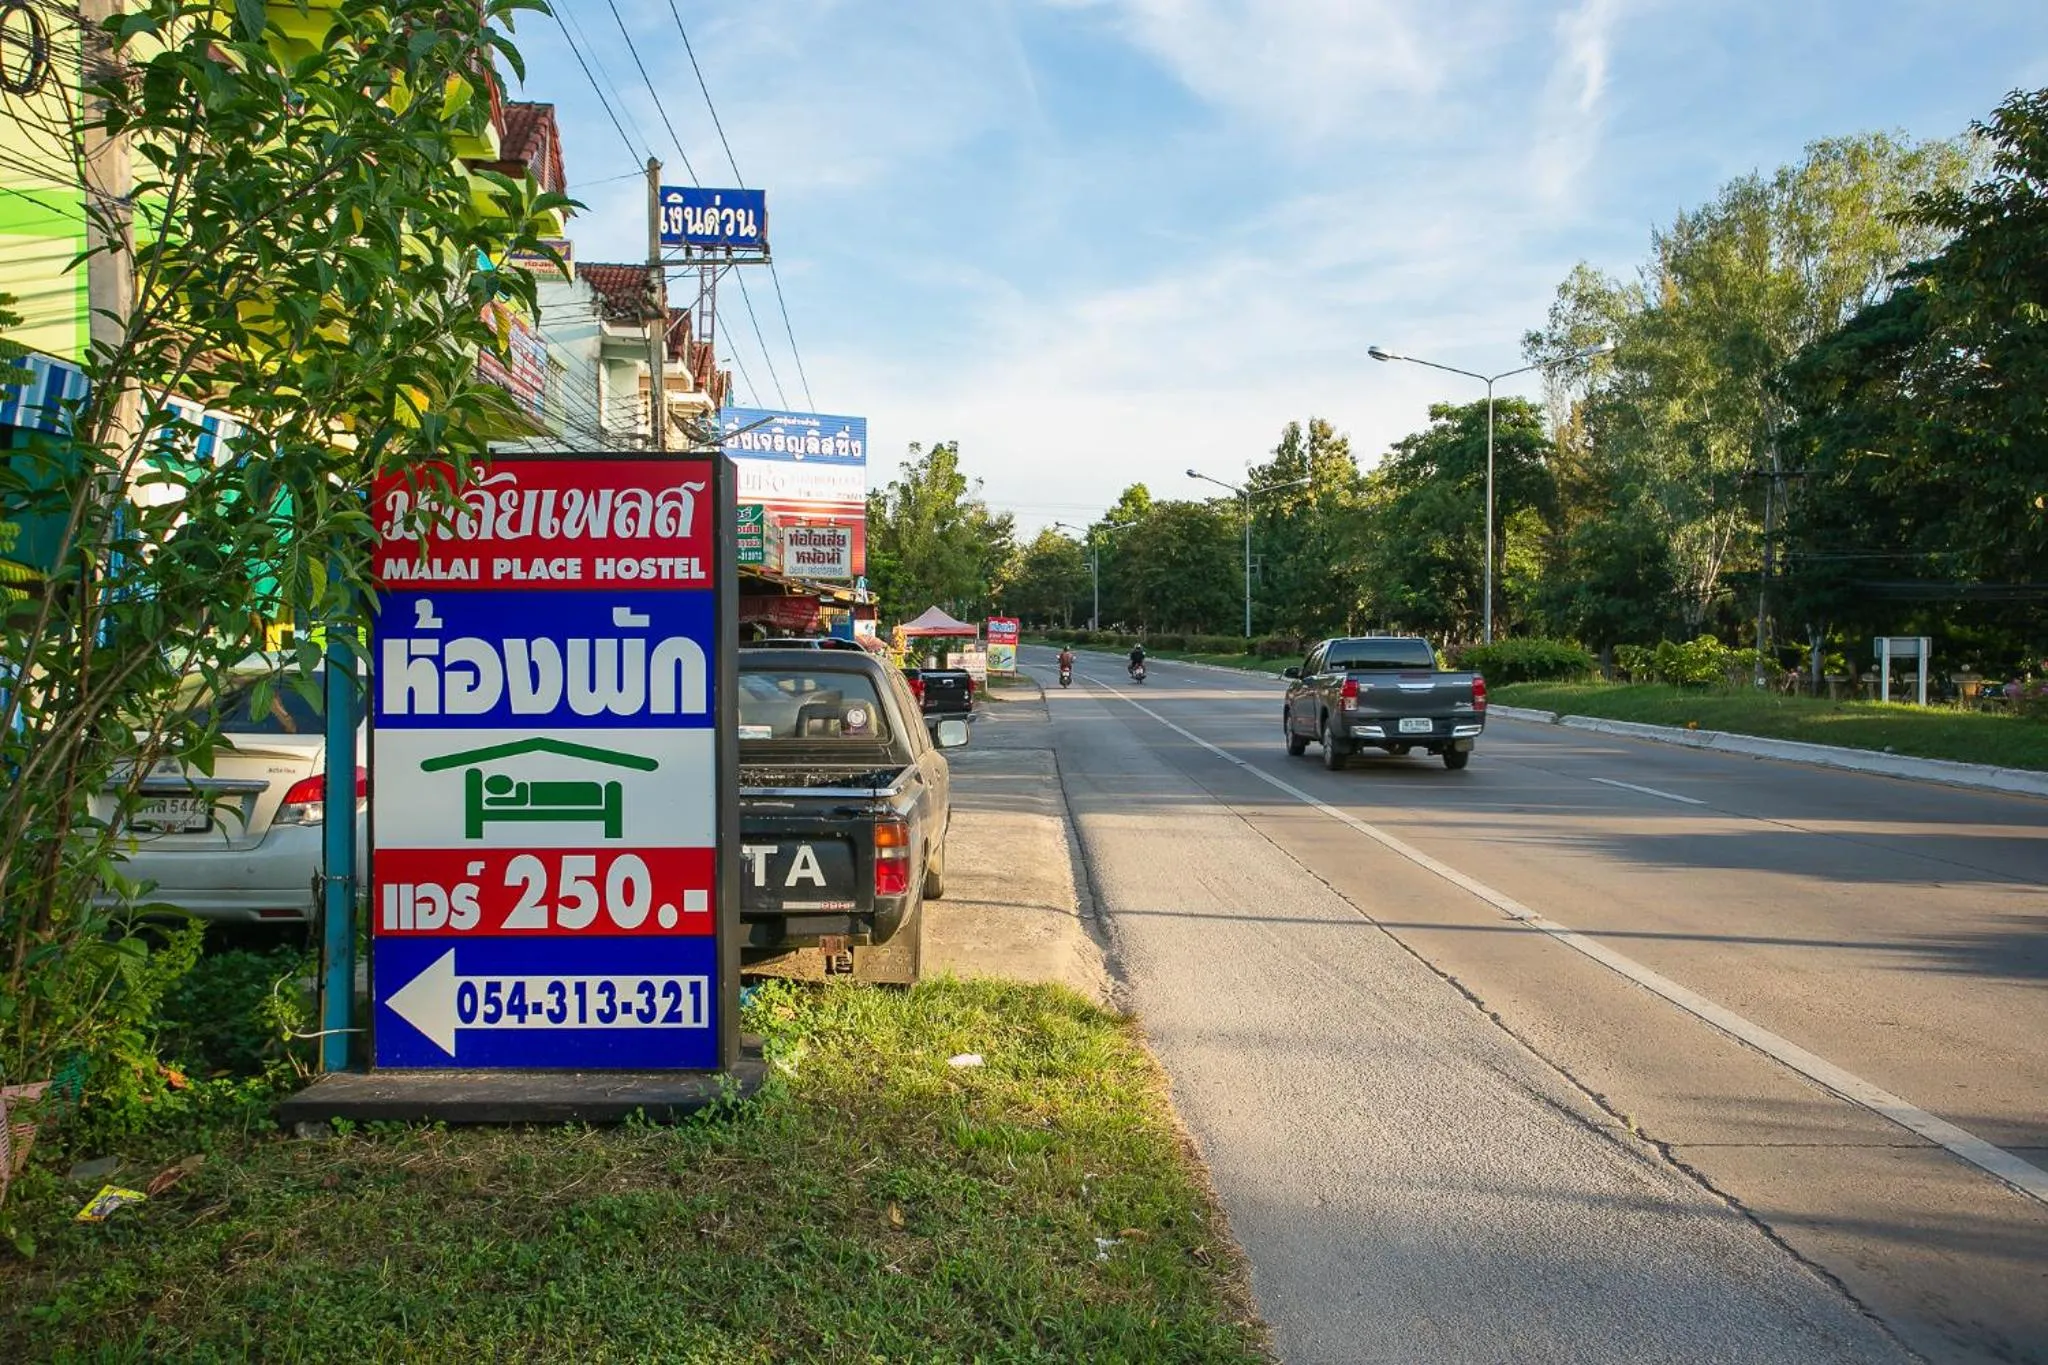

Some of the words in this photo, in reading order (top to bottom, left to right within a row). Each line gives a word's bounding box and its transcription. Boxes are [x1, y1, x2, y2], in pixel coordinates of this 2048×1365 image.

[660, 193, 758, 238] เงินด่วน
[789, 529, 847, 547] ท่อไอเสีย
[796, 548, 844, 565] หม้อน้ำ
[383, 557, 480, 580] MALAI
[493, 557, 582, 580] PLACE
[595, 557, 706, 580] HOSTEL
[383, 599, 707, 716] ห้องพัก
[383, 861, 486, 930] แอร์
[500, 854, 708, 929] 250.-
[457, 980, 702, 1024] 054-313-321
